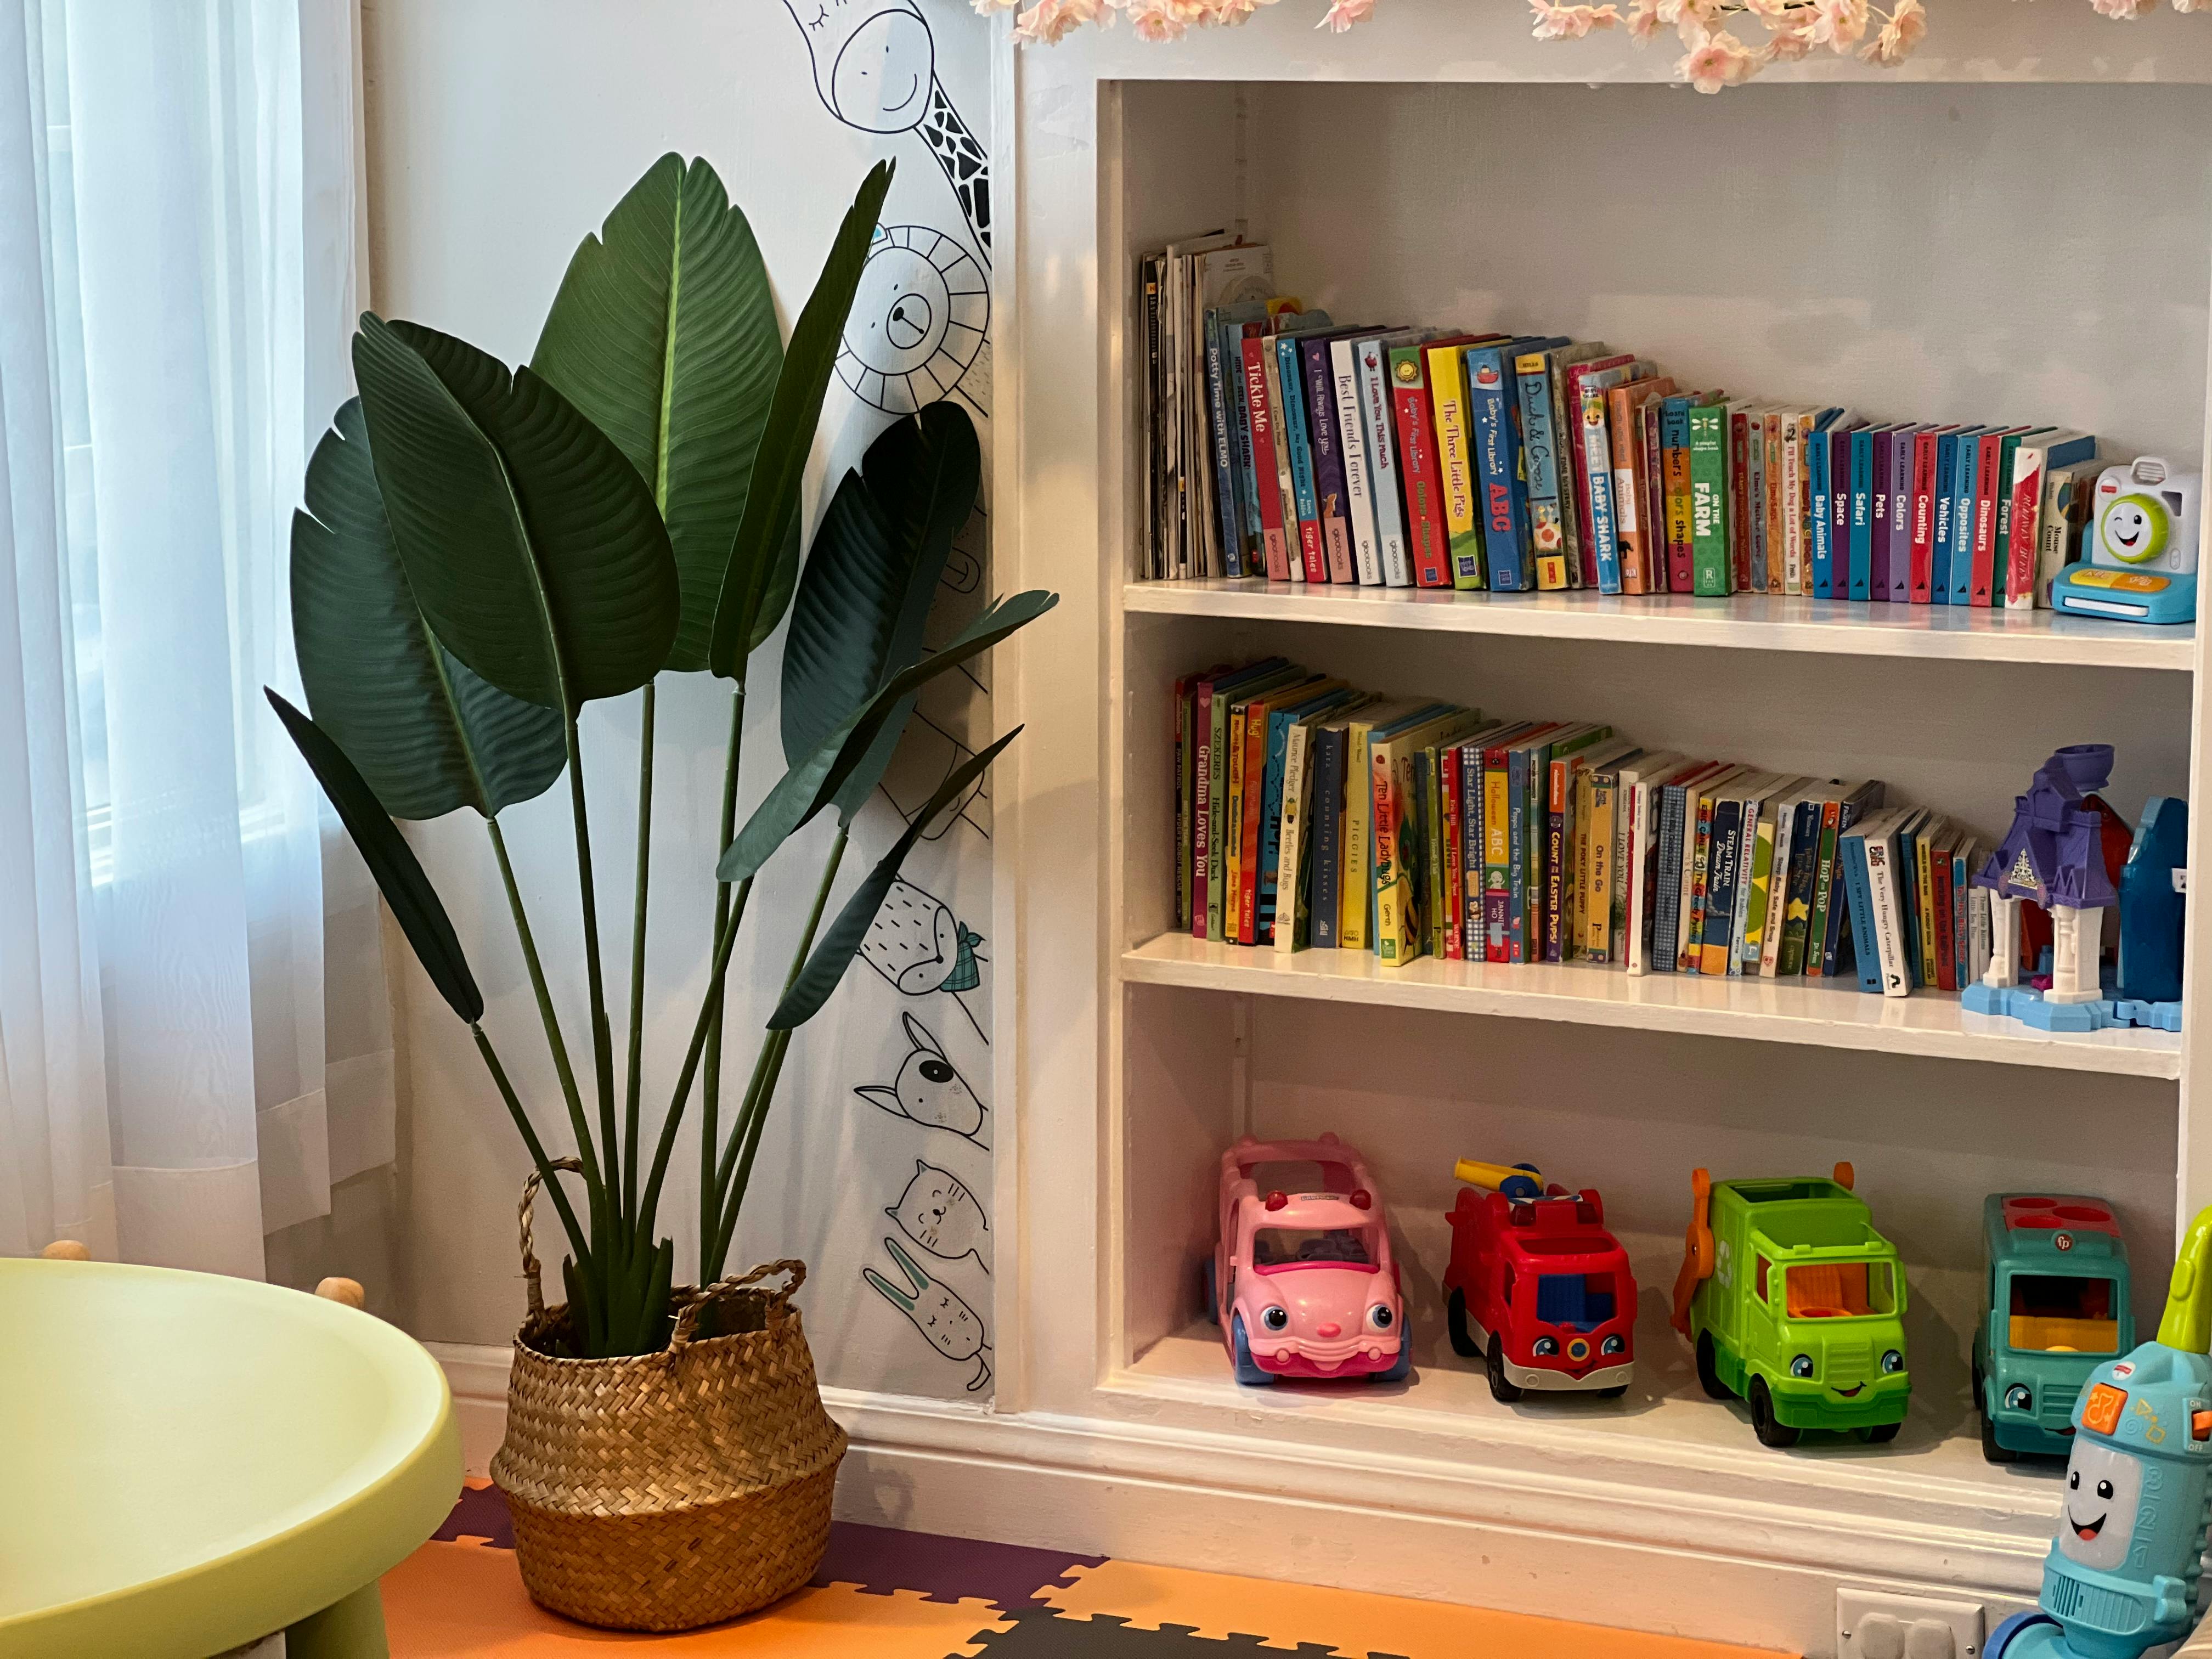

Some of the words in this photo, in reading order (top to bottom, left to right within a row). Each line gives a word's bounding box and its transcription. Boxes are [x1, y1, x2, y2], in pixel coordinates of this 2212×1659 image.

[1210, 348, 1220, 379] Potty
[1213, 381, 1222, 408] Time
[1248, 362, 1263, 408] Tickle
[1315, 375, 1324, 393] Will
[1338, 375, 1353, 401] Best
[1372, 383, 1380, 404] Love
[1314, 394, 1324, 416] Always
[1408, 397, 1419, 425] Baby's
[1443, 400, 1457, 422] The
[1487, 398, 1498, 427] Baby's
[1525, 382, 1545, 426] Duck
[1216, 411, 1224, 435] with
[1238, 406, 1249, 432] BABY
[1253, 410, 1267, 432] Me
[1319, 419, 1329, 436] Love
[1343, 406, 1360, 450] Friends
[1376, 423, 1385, 442] This
[1318, 438, 1329, 455] you
[1409, 428, 1419, 444] First
[1446, 426, 1460, 458] Three
[1488, 430, 1497, 446] First
[1530, 429, 1544, 441] &
[1218, 438, 1228, 467] ELMO
[1379, 444, 1389, 469] Much
[1410, 446, 1420, 473] Library
[1488, 448, 1498, 475] Library
[1588, 435, 1602, 472] MEET
[1672, 430, 1682, 476] numbers
[1348, 454, 1362, 498] Forever
[1450, 461, 1464, 492] Little
[1531, 445, 1549, 491] Goose
[1562, 476, 1571, 510] MYSTERY
[1593, 477, 1606, 511] BABY
[1788, 480, 1796, 490] My
[1453, 495, 1466, 517] Pigs
[1489, 483, 1511, 532] ABC
[1618, 477, 1628, 524] Animals
[1694, 483, 1711, 536] FARM
[1712, 494, 1719, 506] ON
[1814, 495, 1825, 518] Baby
[1835, 493, 1846, 526] Space
[1855, 493, 1865, 526] Safari
[1876, 494, 1885, 518] Pets
[1895, 495, 1906, 531] Colors
[1915, 495, 1928, 544] Counting
[1938, 497, 1950, 543] Vehicles
[1958, 498, 1971, 552] Opposites
[1978, 500, 1990, 551] Dinosaurs
[2000, 499, 2011, 534] Forest
[1306, 527, 1314, 549] tiger
[1332, 528, 1344, 570] igloobooks
[1596, 516, 1611, 561] SHARK
[1673, 520, 1686, 558] shapes
[1816, 521, 1827, 559] Animals
[2045, 525, 2054, 551] Count
[2053, 526, 2062, 554] Mouse
[1308, 551, 1317, 572] tales
[1362, 540, 1373, 580] igloobooks
[1390, 540, 1401, 579] igloobooks
[1248, 719, 1261, 738] Hug!
[1213, 727, 1222, 780] SZEKERES
[1291, 733, 1301, 763] Maurice
[1197, 746, 1210, 804] Grandma
[1288, 765, 1299, 792] Pledger
[1376, 781, 1387, 800] Ten
[1491, 781, 1500, 825] Halloween
[1197, 810, 1209, 848] Loves
[1211, 797, 1220, 856] Hide-and-Seek
[1322, 790, 1331, 851] counting
[1377, 803, 1389, 833] Little
[1511, 808, 1521, 828] Peppa
[1285, 829, 1294, 854] Beetles
[1351, 820, 1359, 873] PIGGIES
[1468, 840, 1476, 868] Bright
[1491, 828, 1503, 856] ABC
[1550, 832, 1560, 864] COUNT
[1596, 845, 1604, 859] On
[1698, 826, 1706, 854] CARLE
[1725, 830, 1736, 858] STEAM
[1195, 855, 1208, 877] You
[1284, 856, 1292, 871] and
[1379, 836, 1391, 885] Ladybugs
[1666, 856, 1674, 874] Gruff
[1714, 841, 1725, 870] Dream
[1741, 844, 1750, 884] RELATIVITY
[1210, 860, 1218, 881] Duck
[1280, 873, 1291, 890] Bugs
[1322, 860, 1331, 901] kisses
[1511, 865, 1521, 877] Big
[1713, 870, 1723, 893] Train
[1513, 879, 1521, 898] Train
[1550, 876, 1560, 910] EASTER
[1595, 879, 1602, 892] Go
[1491, 908, 1498, 918] HO
[1691, 888, 1701, 915] Greedy
[1549, 914, 1559, 944] PUPS!
[1690, 917, 1699, 944] Python
[1767, 926, 1775, 943] Snug
[1862, 926, 1870, 956] ANIMALS
[1884, 933, 1894, 967] Caterpillar
[2058, 1236, 2069, 1249] fp
[2188, 1444, 2203, 1452] OFF
[2145, 1466, 2162, 1491] 3
[2137, 1506, 2155, 1531] 2
[2134, 1545, 2148, 1568] 1
